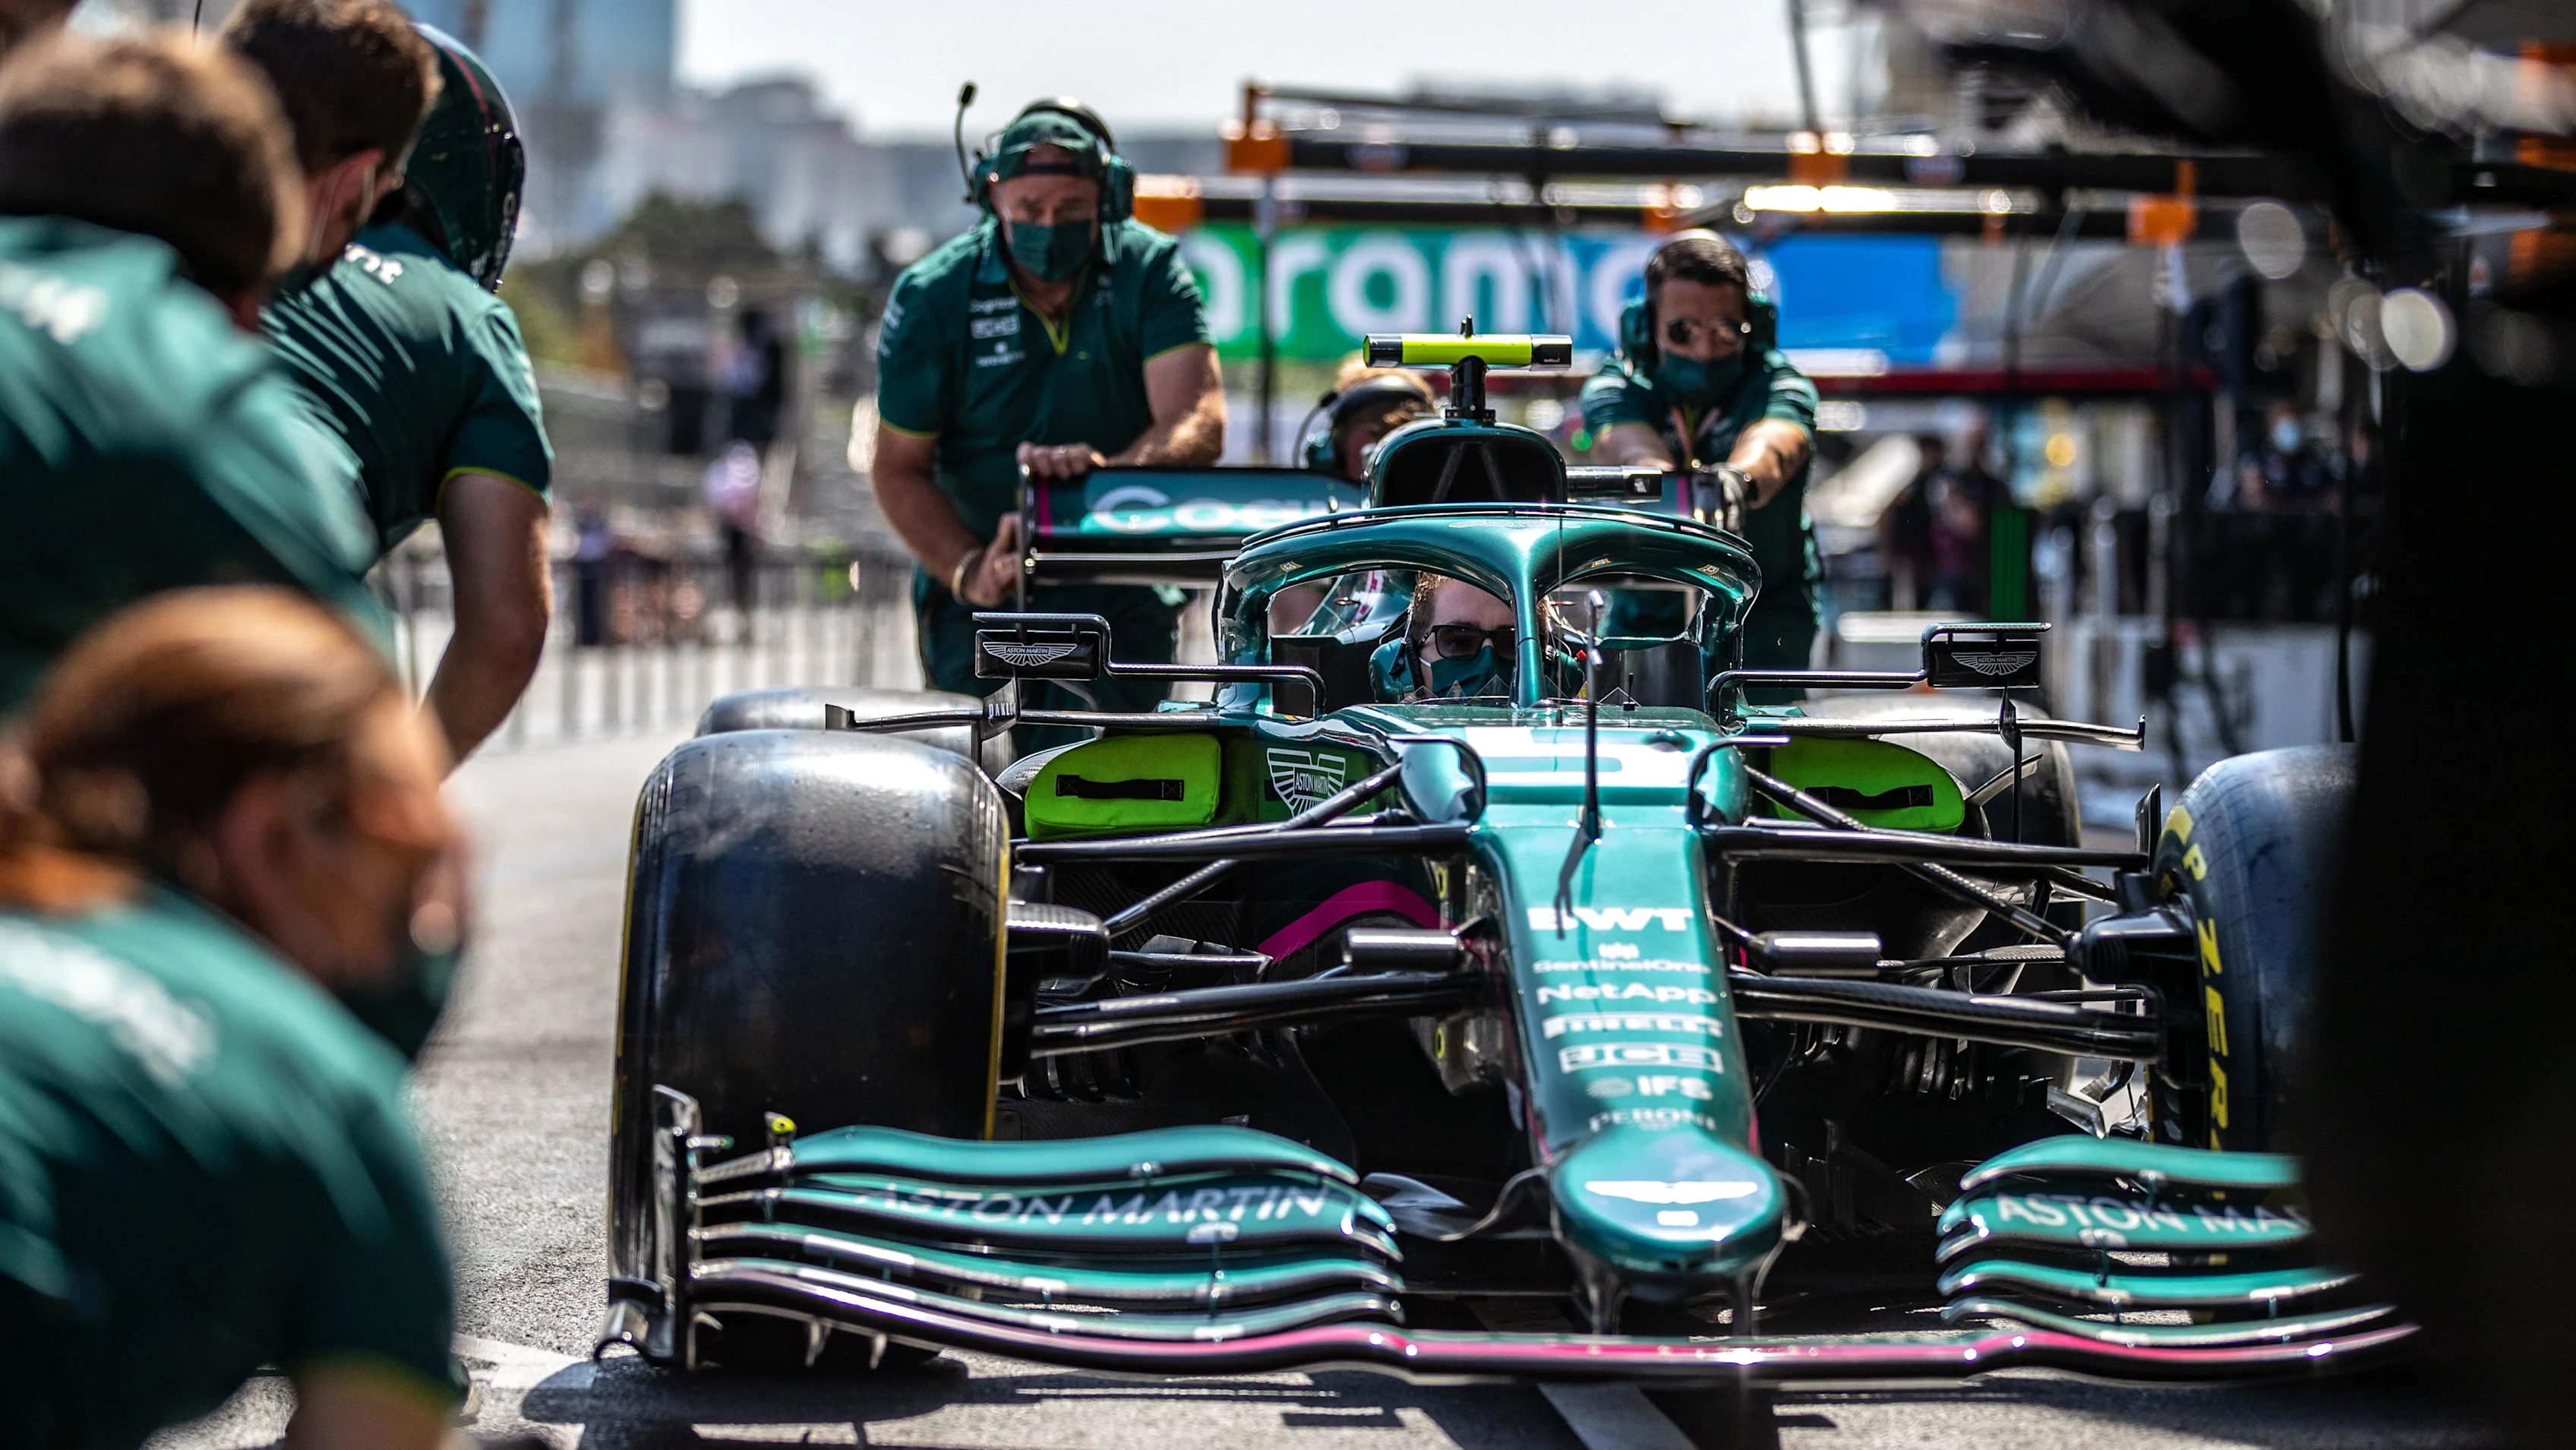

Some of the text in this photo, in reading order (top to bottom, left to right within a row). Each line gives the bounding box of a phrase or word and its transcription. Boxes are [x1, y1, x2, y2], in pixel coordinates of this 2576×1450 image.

[1295, 772, 1314, 791] ASTON
[1526, 907, 1694, 931] BWT
[1533, 959, 1710, 974] SentinelOne
[1536, 982, 1718, 1005] NetApp
[1637, 1075, 1713, 1100] IFS
[1589, 1108, 1716, 1132] PERONI
[854, 1183, 1329, 1224] ASTON MARTIN
[1996, 1193, 2188, 1232] ASTON
